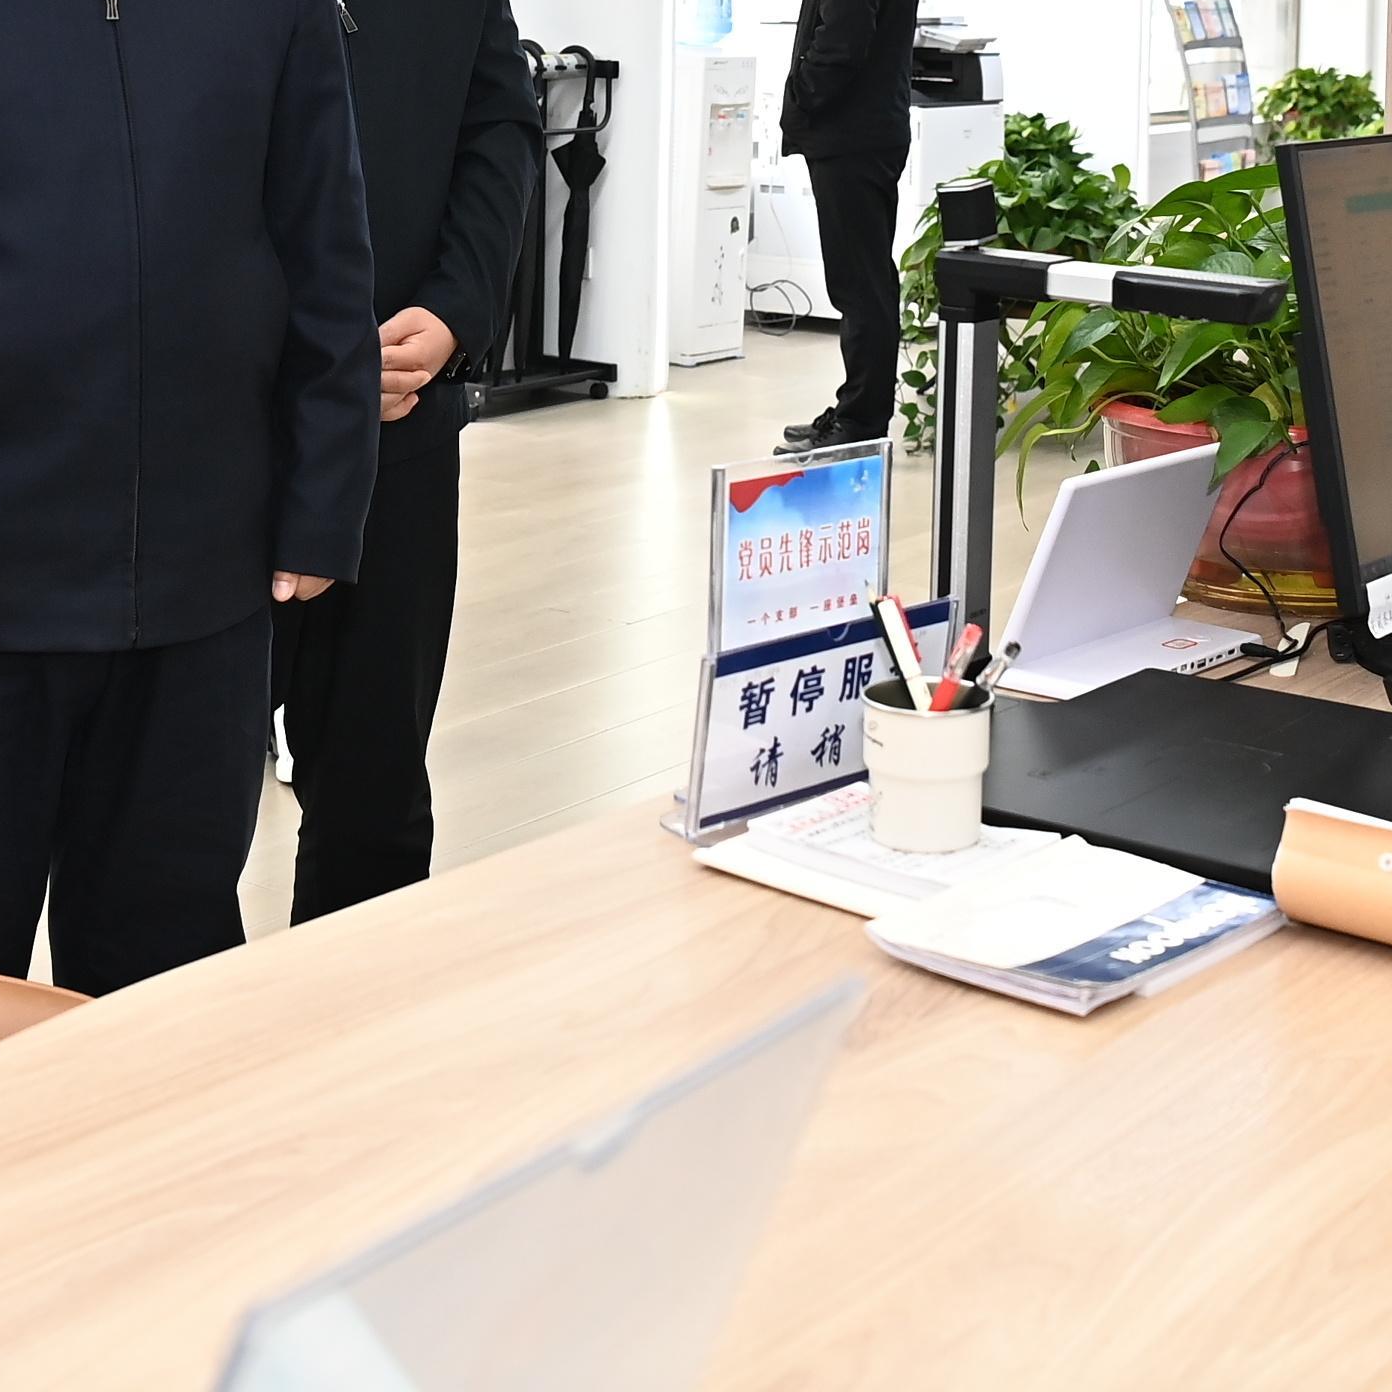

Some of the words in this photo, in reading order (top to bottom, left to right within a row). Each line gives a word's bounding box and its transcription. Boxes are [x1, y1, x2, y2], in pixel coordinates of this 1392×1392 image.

[738, 516, 872, 582] 党员先锋示范岗
[747, 605, 800, 625] 一个支部
[739, 651, 900, 730] 暂停服
